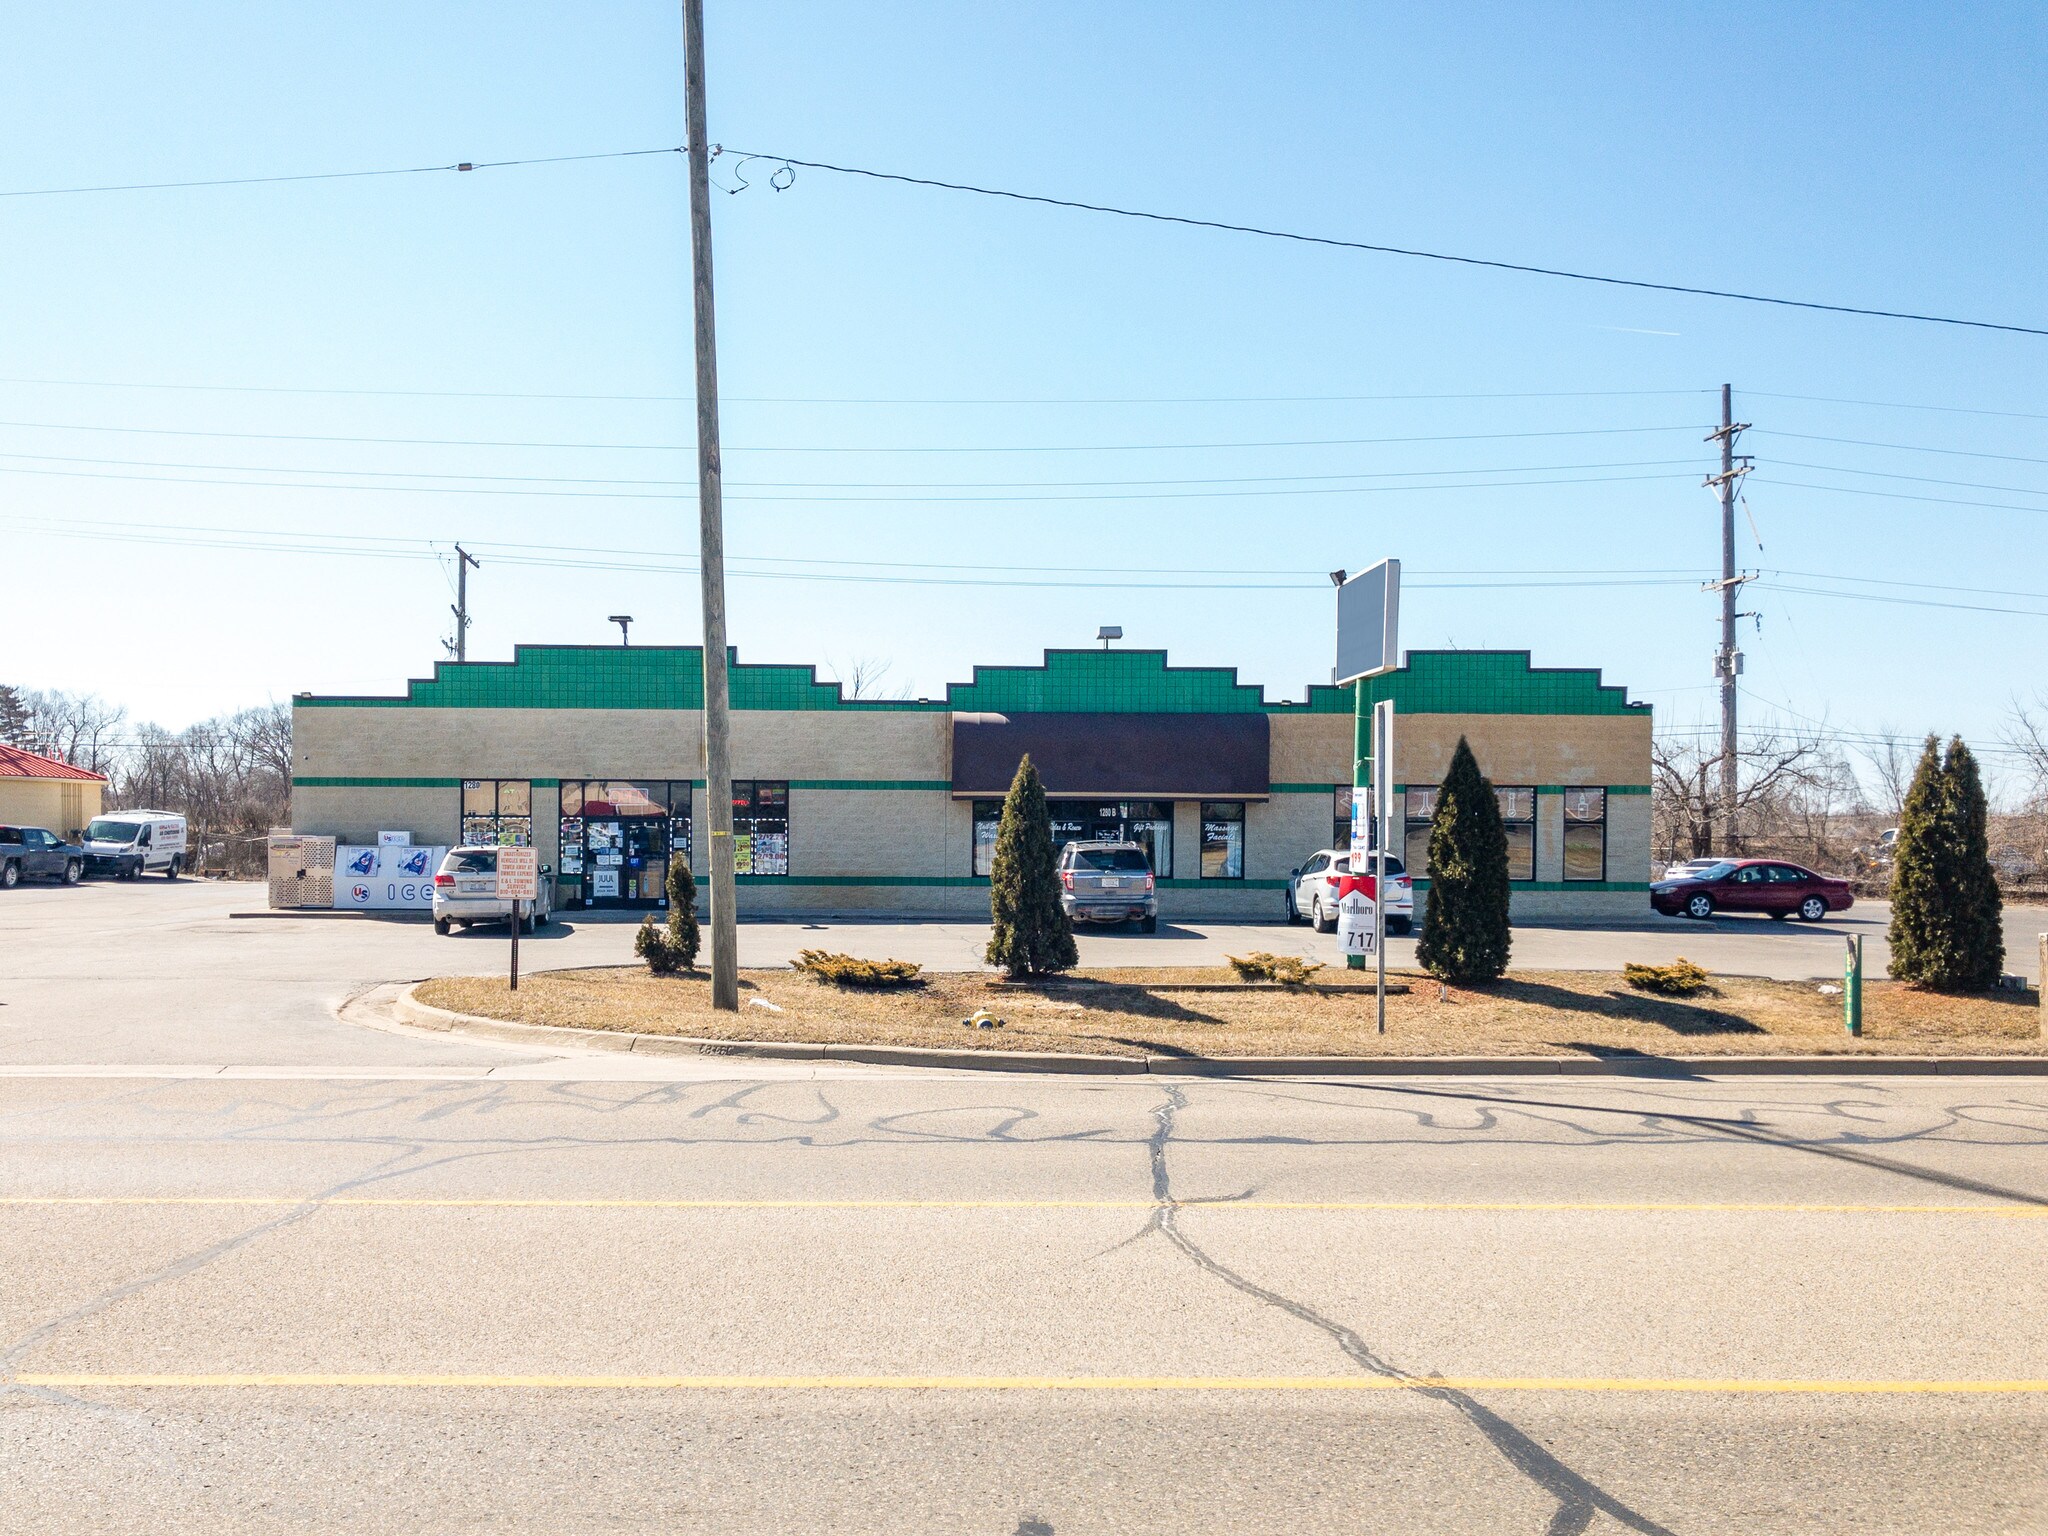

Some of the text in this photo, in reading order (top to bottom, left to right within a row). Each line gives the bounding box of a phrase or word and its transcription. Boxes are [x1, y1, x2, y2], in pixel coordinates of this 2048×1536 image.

[1205, 823, 1239, 832] Massage
[1207, 833, 1233, 842] Facials
[1341, 898, 1373, 914] Marlboro
